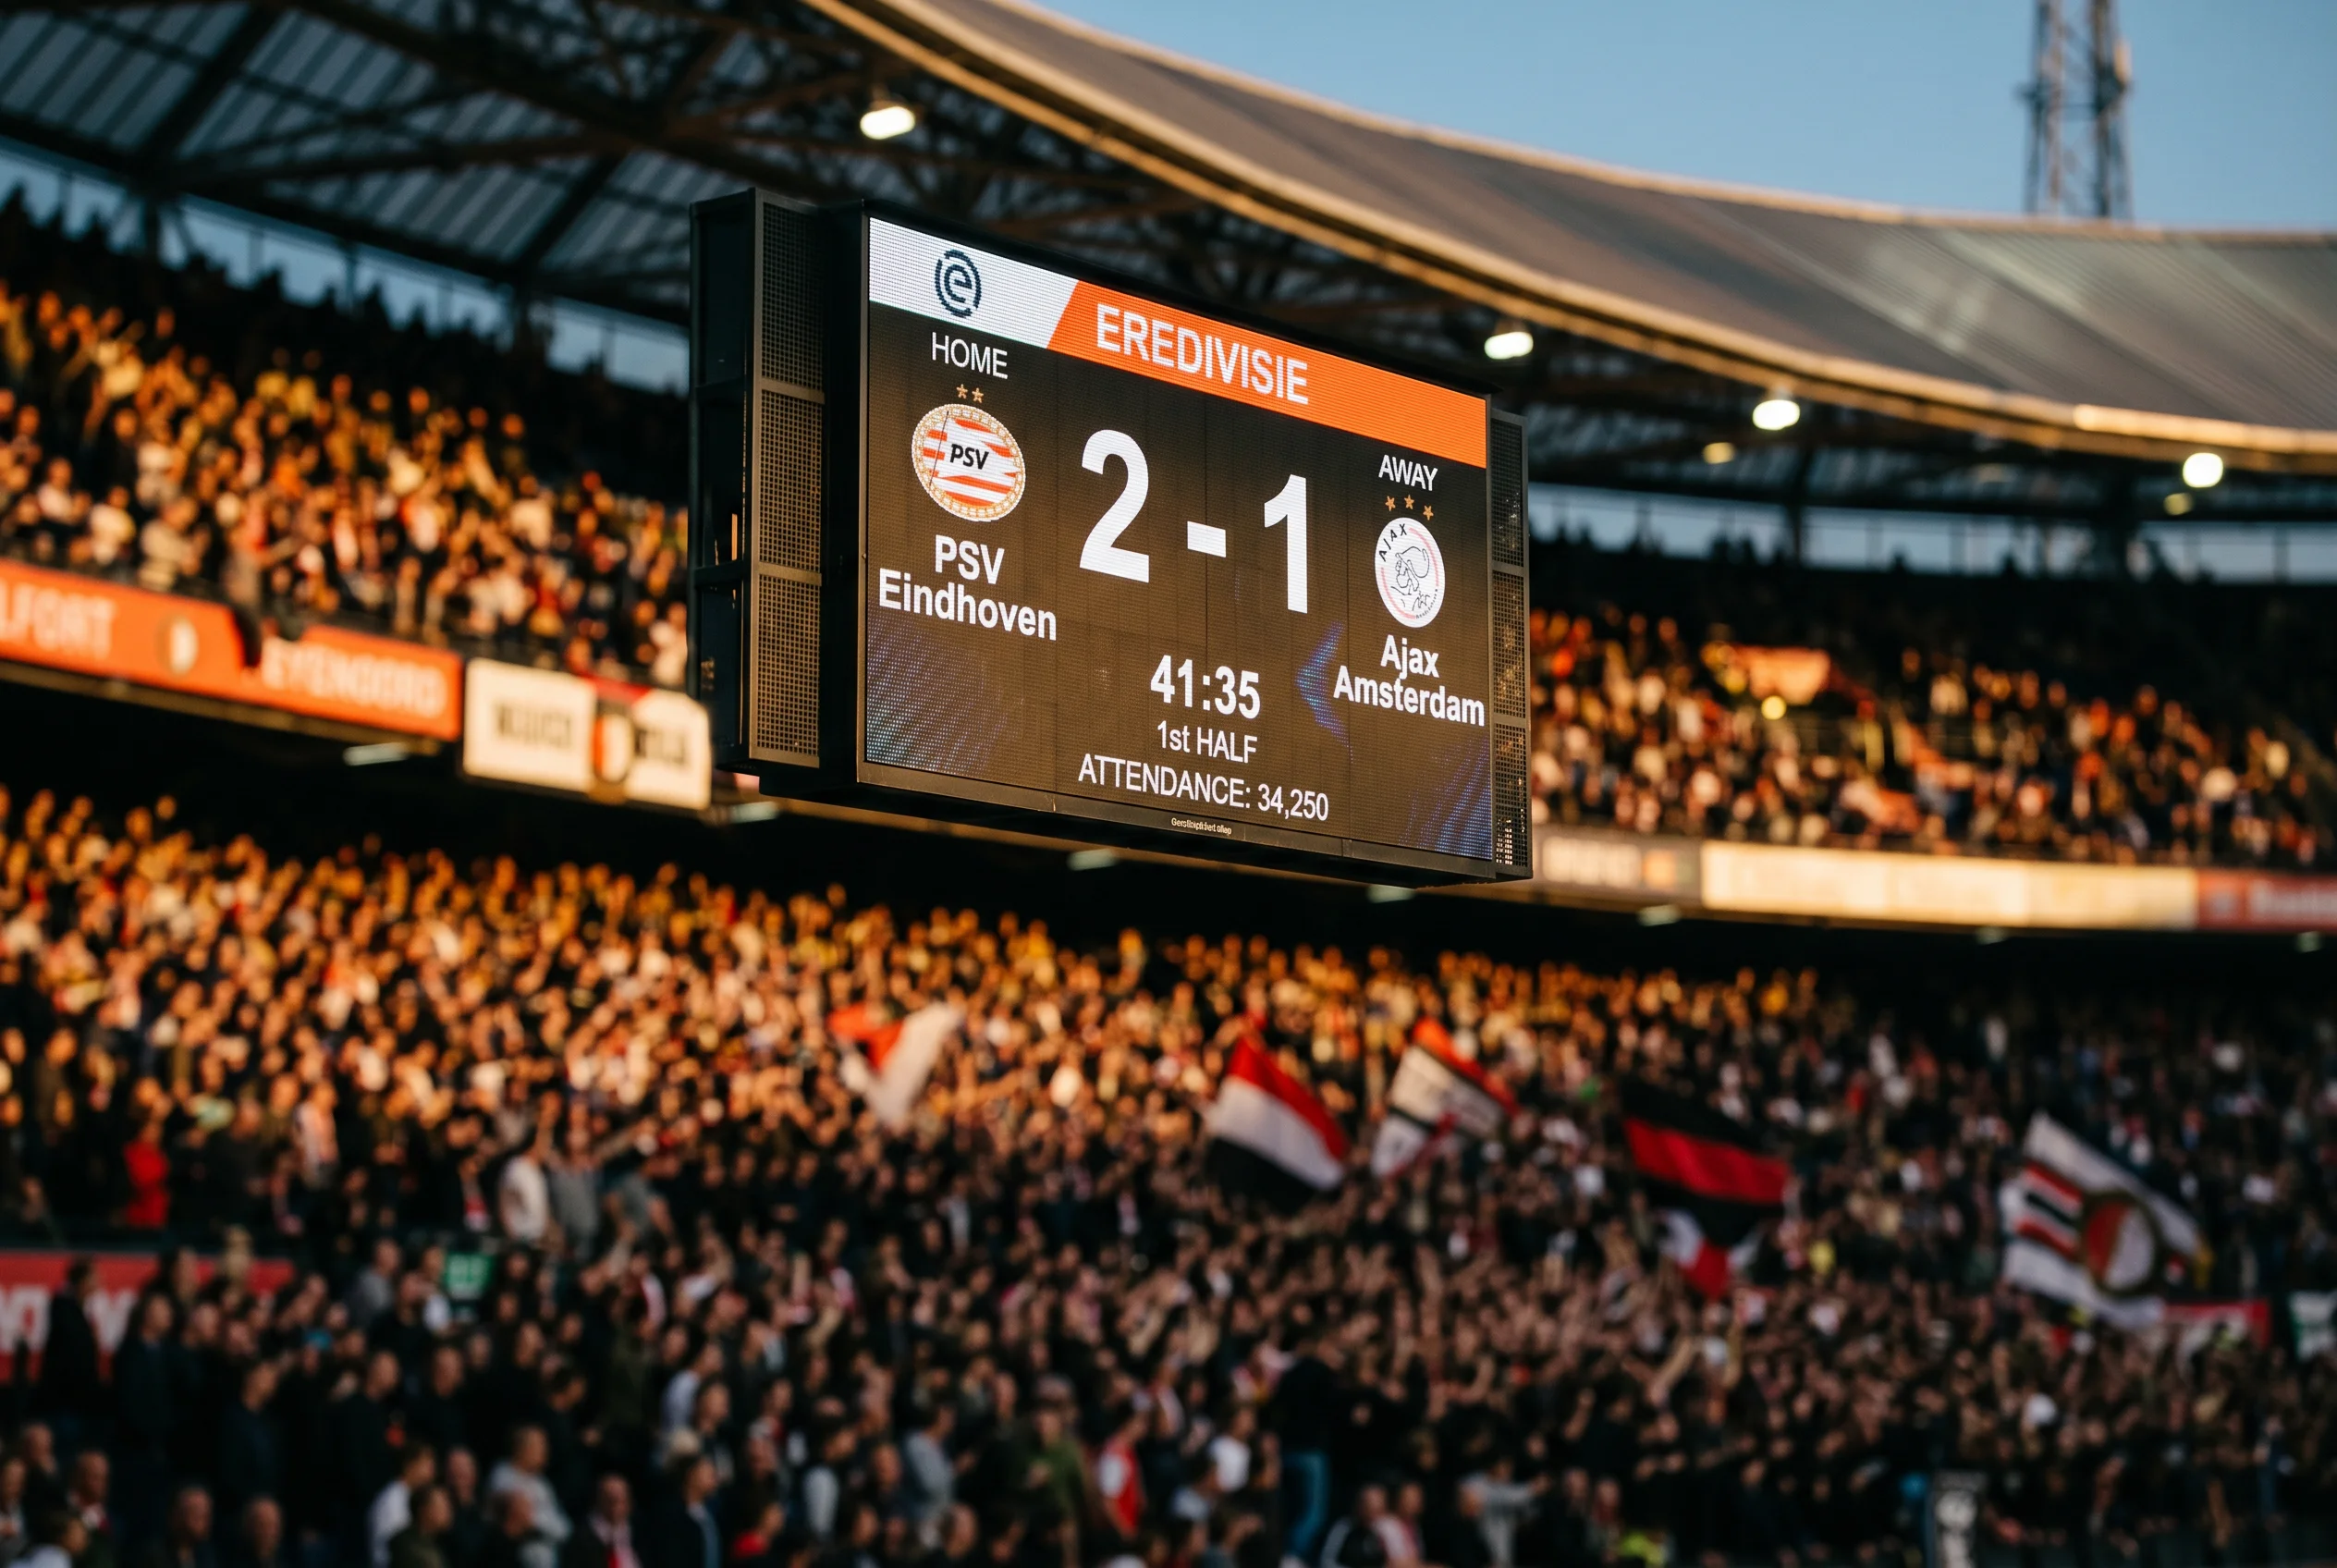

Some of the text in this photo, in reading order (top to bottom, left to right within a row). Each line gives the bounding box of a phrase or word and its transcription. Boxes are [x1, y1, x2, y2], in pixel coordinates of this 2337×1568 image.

[932, 332, 1009, 380] HOME
[1096, 303, 1309, 405] EREDIVISIE
[949, 444, 989, 470] PSV
[1378, 454, 1438, 492] AWAY
[1079, 429, 1308, 614] 2 - 1
[935, 533, 1005, 585] PSV
[879, 567, 1057, 642] Eindhoven
[1380, 634, 1439, 680] Ajax
[1150, 655, 1261, 719] 41:35
[1333, 665, 1485, 727] Amsterdam
[1156, 720, 1258, 764] 1st HALF
[1078, 753, 1329, 821] ATTENDANCE: 34,250
